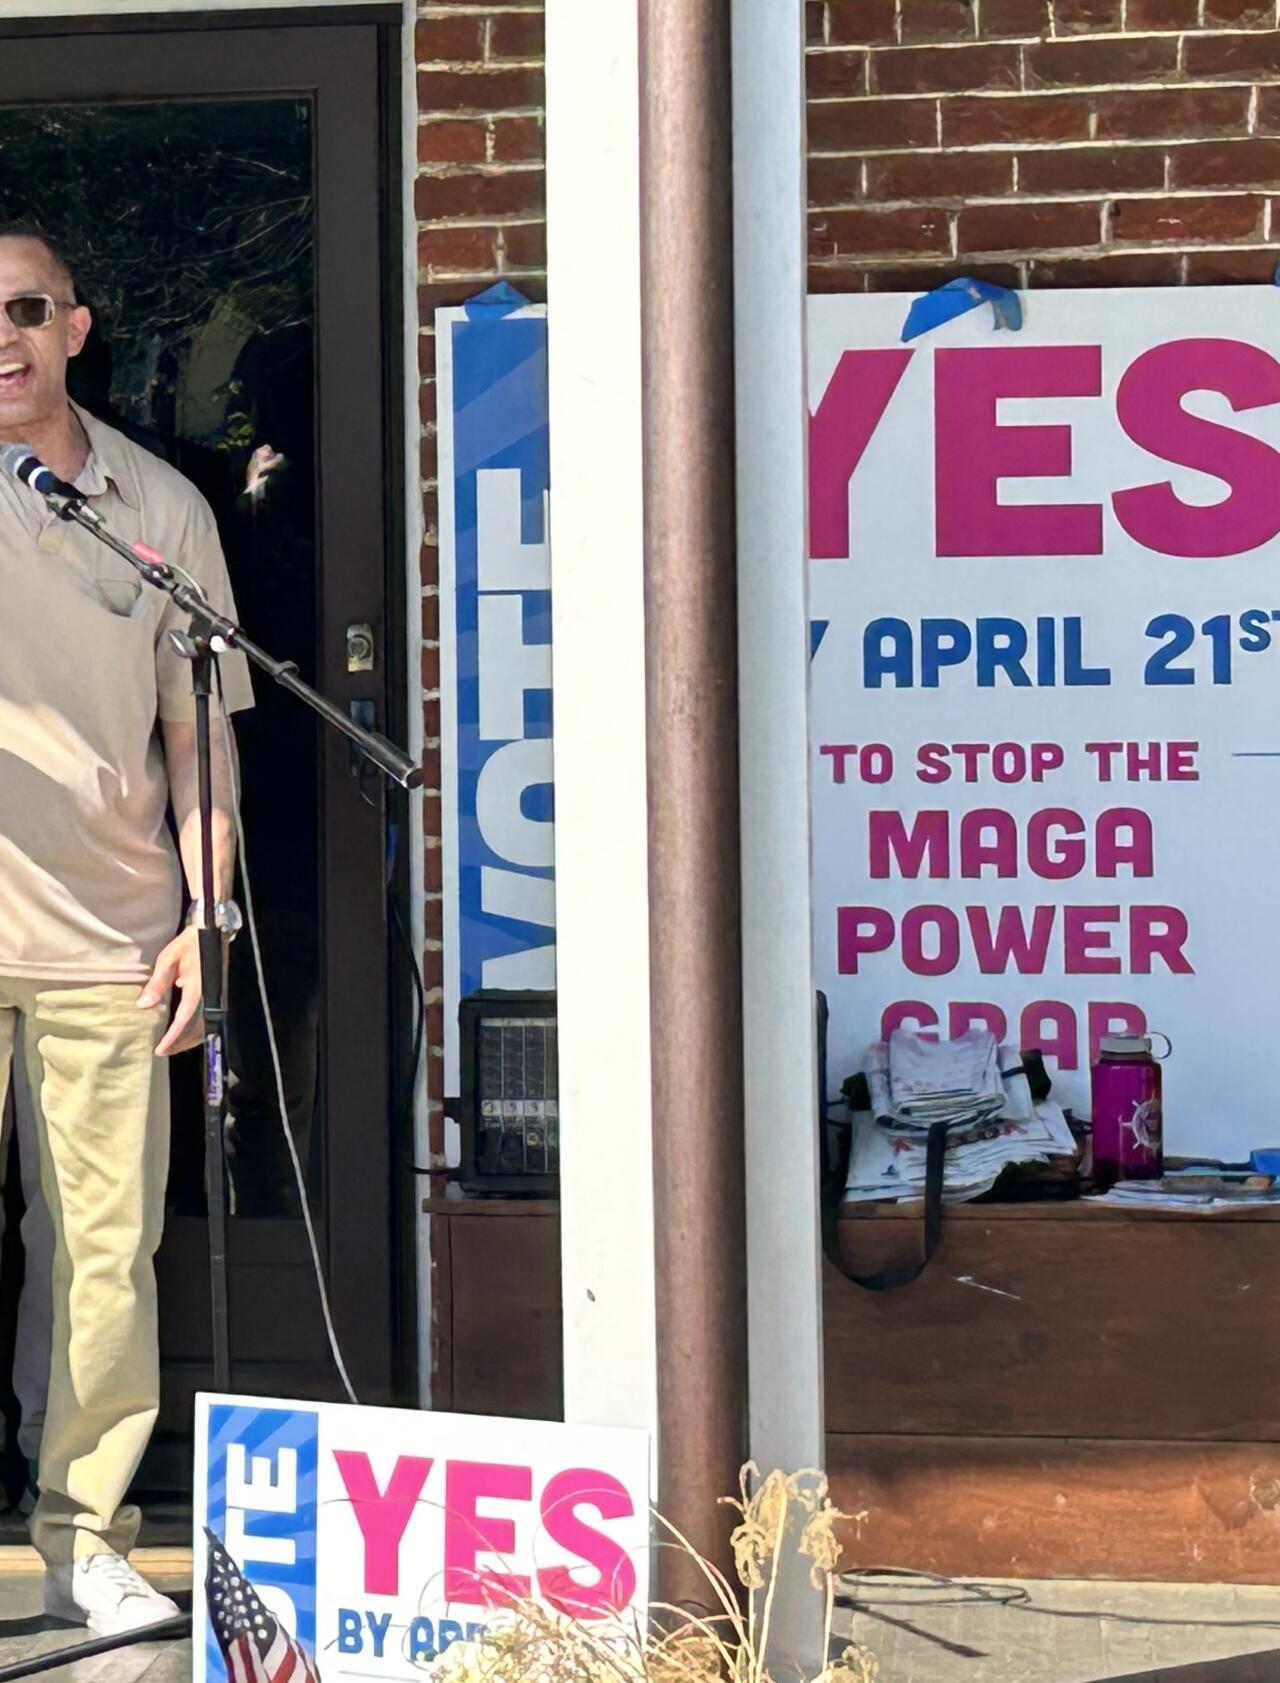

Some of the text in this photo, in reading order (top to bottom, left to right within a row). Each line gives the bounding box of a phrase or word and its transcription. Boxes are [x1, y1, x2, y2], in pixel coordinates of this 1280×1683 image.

[863, 617, 1111, 687] APRIL
[1144, 609, 1280, 685] 21S
[820, 741, 1200, 784] TO STOP THE
[869, 808, 1154, 879] MAGA
[837, 905, 1196, 976] POWER
[332, 1449, 637, 1620] YES
[338, 1608, 393, 1658] BY
